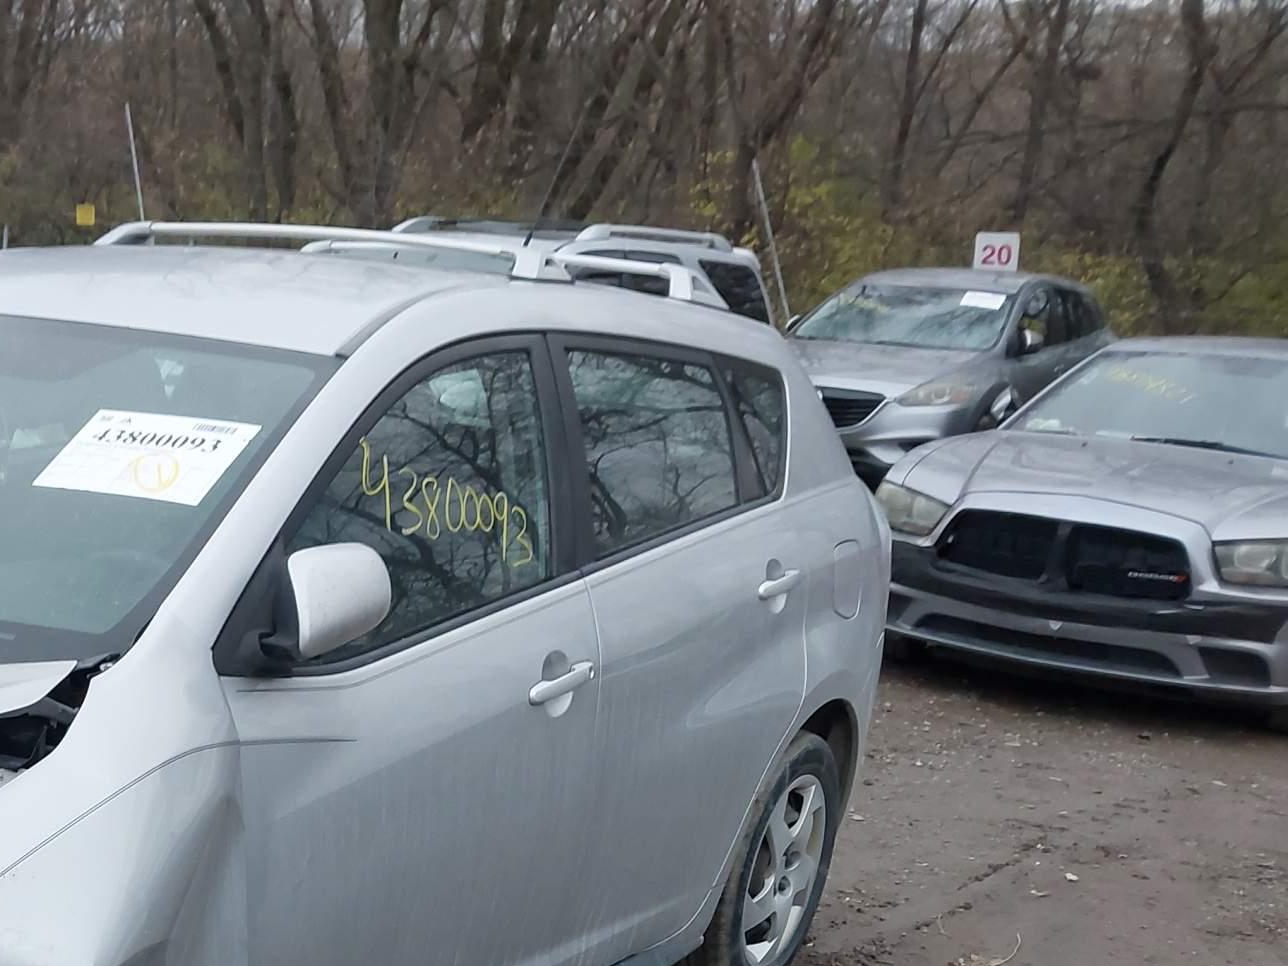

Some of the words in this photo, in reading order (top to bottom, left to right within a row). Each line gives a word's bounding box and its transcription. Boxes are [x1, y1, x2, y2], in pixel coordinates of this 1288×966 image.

[981, 244, 1012, 266] 20
[93, 428, 223, 454] 43800093
[359, 435, 534, 568] 43800093
